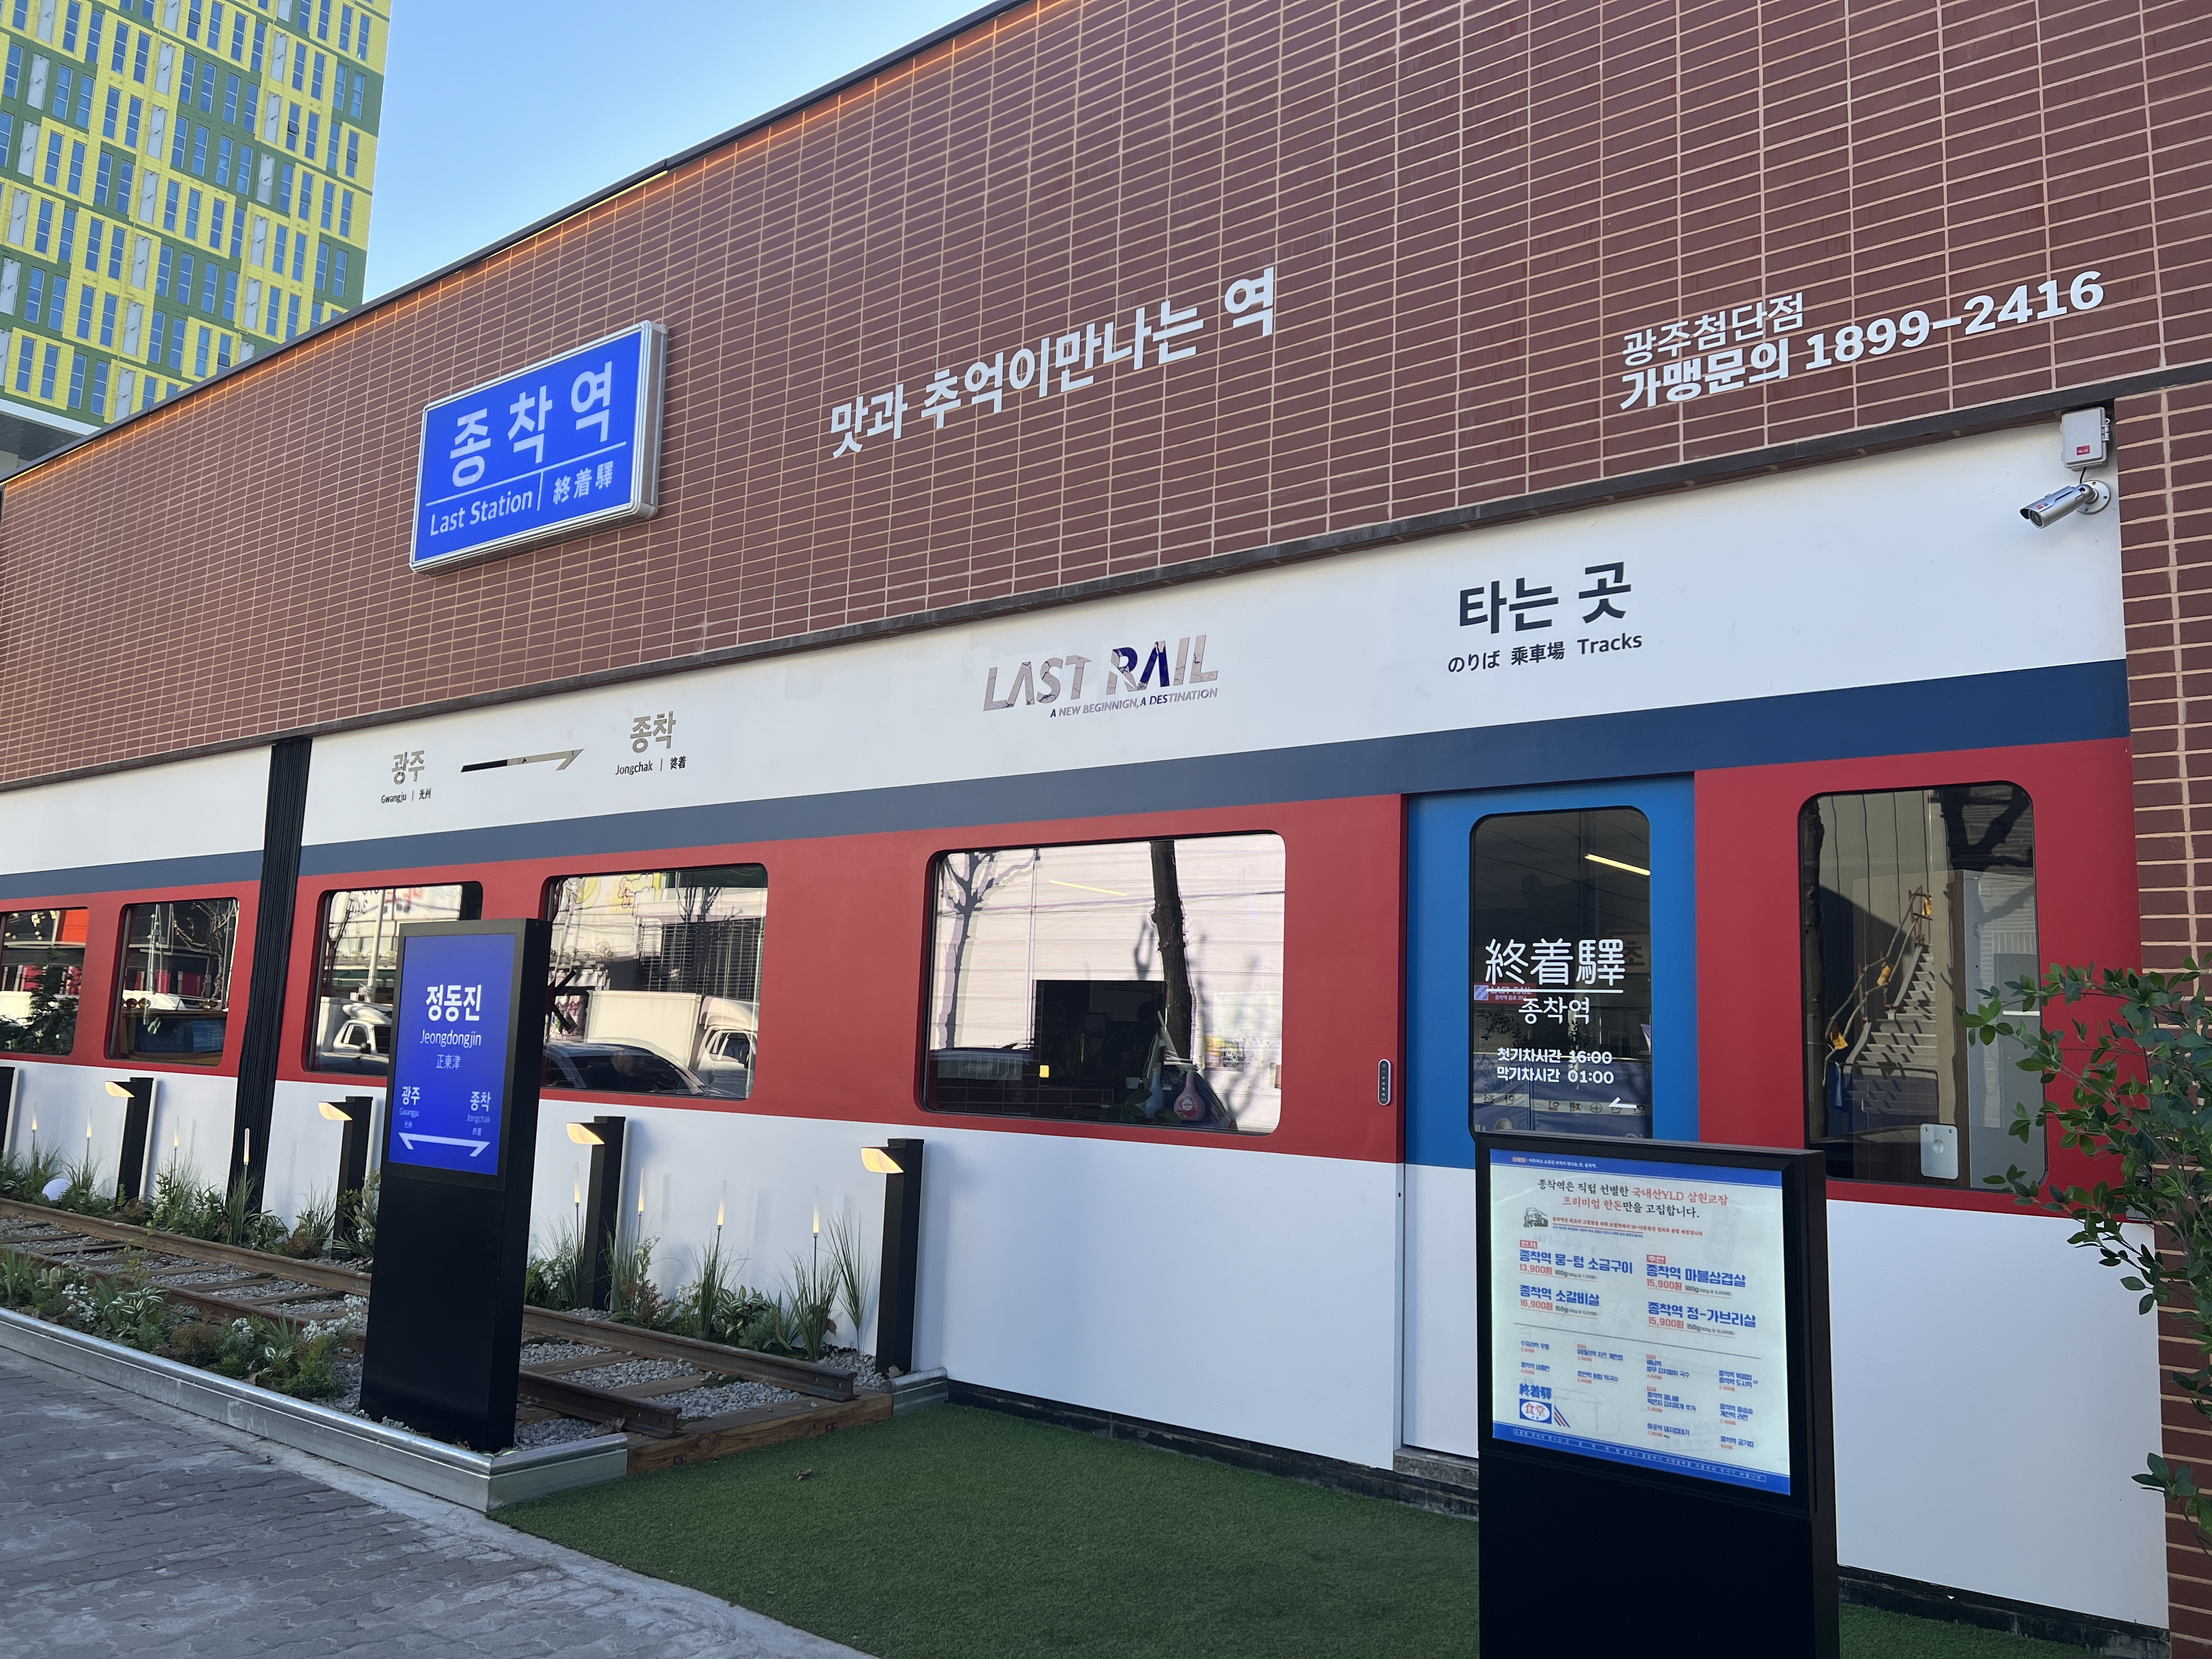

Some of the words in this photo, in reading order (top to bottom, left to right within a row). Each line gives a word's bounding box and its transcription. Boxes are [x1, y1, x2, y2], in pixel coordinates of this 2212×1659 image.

[1620, 337, 1790, 411] 가맹문의
[1805, 270, 2104, 370] 1899-2416
[1622, 292, 1804, 367] 광주첨단점
[831, 383, 908, 459] 맛과
[1224, 266, 1275, 337] 역
[449, 361, 612, 488] 종착역
[430, 506, 465, 537] Last
[469, 489, 532, 525] Station
[1459, 577, 1559, 634] 타는
[1578, 561, 1632, 624] 곳
[1448, 650, 1500, 673] のりば
[1511, 641, 1565, 666] 乗車場
[1577, 633, 1642, 655] Tracks
[983, 655, 1092, 712] LAST
[1105, 634, 1218, 695] RAIL
[1049, 708, 1056, 718] A
[1058, 706, 1081, 717] NEW
[1140, 696, 1147, 707] A
[1149, 688, 1218, 706] DESTINATION
[630, 711, 676, 753] 종착
[391, 749, 425, 785] 광주
[615, 760, 653, 776] Jongchak
[381, 792, 407, 804] Gwangju
[1485, 938, 1626, 986] 終着驛
[426, 985, 482, 1022] 정동진
[1518, 996, 1590, 1025] 종착역
[420, 1029, 481, 1048] Jeongdongjin
[436, 1054, 461, 1070] 正東津
[1497, 1047, 1562, 1063] 첫기차시간
[1568, 1051, 1613, 1065] 16:00
[1497, 1066, 1560, 1083] 막기차시간
[1567, 1070, 1615, 1084] 01:00
[401, 1086, 420, 1105] 광주
[470, 1091, 492, 1111] 종착
[399, 1107, 420, 1119] Gwangju
[466, 1113, 490, 1125] Jongchak
[1537, 1178, 1574, 1192] 종착역은
[1577, 1182, 1595, 1194] 직접
[1600, 1184, 1628, 1197] 선별한
[1632, 1187, 1683, 1202] 국내산YLD
[1688, 1192, 1728, 1206] 삼원교잡
[1562, 1195, 1600, 1209] 프리미엄
[1603, 1199, 1642, 1214] 한돈만을
[1646, 1203, 1699, 1219] 고집합니다.
[1520, 1249, 1551, 1264] 종착역
[1588, 1257, 1632, 1274] 소금구이
[1520, 1263, 1552, 1276] 13,900원
[1646, 1264, 1680, 1279] 종착역
[1685, 1268, 1746, 1288] 마블삼겹살
[1646, 1278, 1681, 1291] 15,900원
[1520, 1285, 1551, 1300] 종착역
[1556, 1289, 1599, 1306] 소갈비살
[1520, 1299, 1552, 1311] 16,900원
[1648, 1302, 1683, 1318] 종착역
[1687, 1307, 1756, 1328] 정-가브리살
[1648, 1317, 1684, 1330] 15,900원
